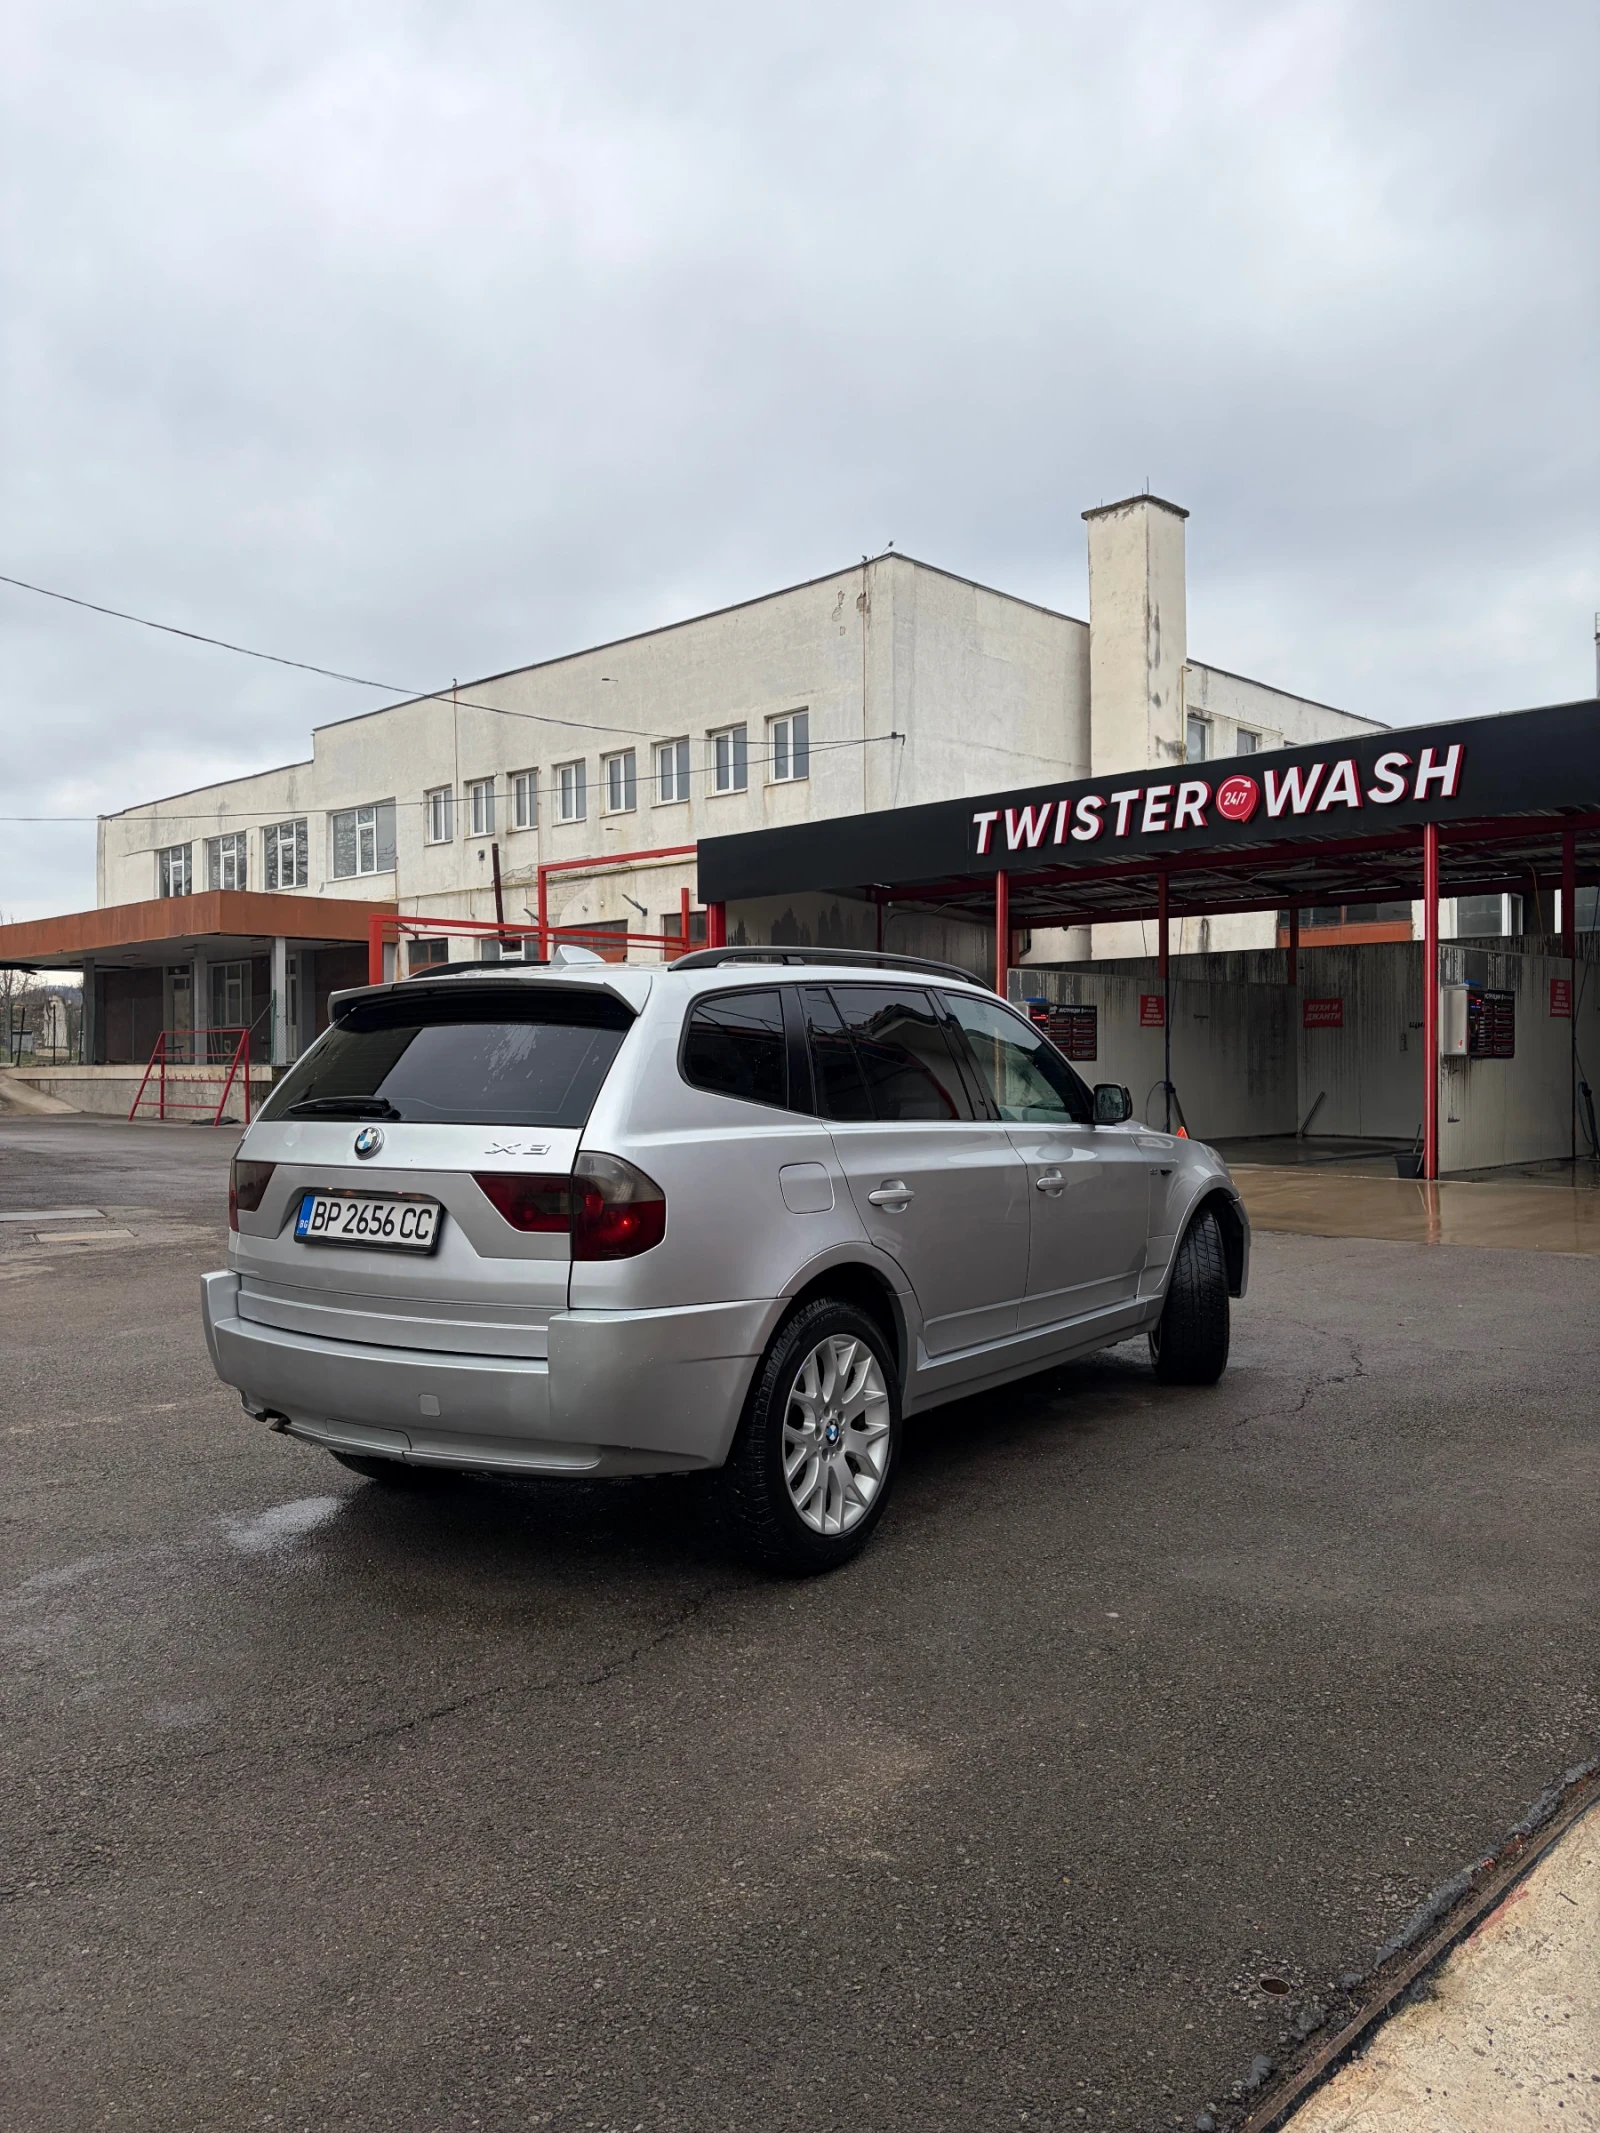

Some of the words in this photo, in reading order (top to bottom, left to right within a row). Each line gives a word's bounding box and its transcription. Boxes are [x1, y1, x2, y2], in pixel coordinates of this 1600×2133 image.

[973, 780, 1211, 855] TWISTER
[1223, 790, 1248, 806] 24/7
[1264, 744, 1464, 818] WASH
[1305, 1012, 1341, 1022] ДЖАНТИ
[484, 1142, 552, 1156] X3
[299, 1219, 309, 1229] BG
[311, 1201, 342, 1232] BP
[342, 1203, 396, 1237] 2656
[400, 1207, 433, 1240] CC
